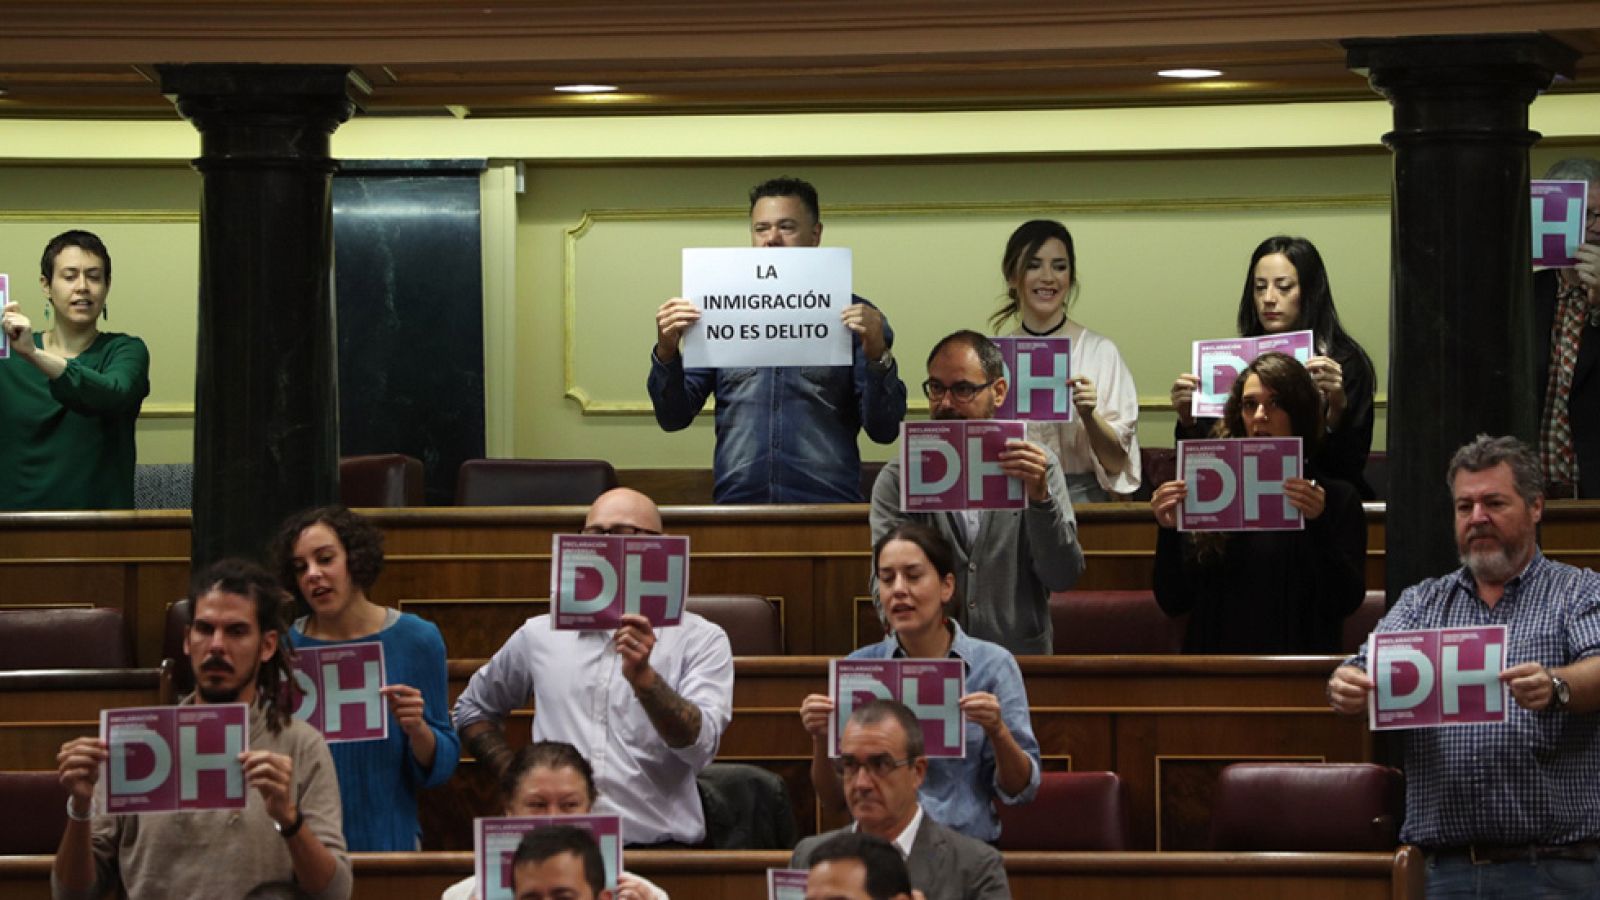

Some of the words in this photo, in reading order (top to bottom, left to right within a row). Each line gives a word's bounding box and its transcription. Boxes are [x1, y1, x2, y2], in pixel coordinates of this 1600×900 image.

[703, 290, 831, 309] INMIGRACIÓN
[756, 265, 778, 279] LA
[707, 325, 734, 339] NO
[740, 325, 760, 339] ES
[765, 324, 829, 339] DELITO
[1184, 456, 1298, 519] DH
[560, 554, 683, 619] DH
[1378, 644, 1502, 714] DH
[110, 725, 243, 800] DH
